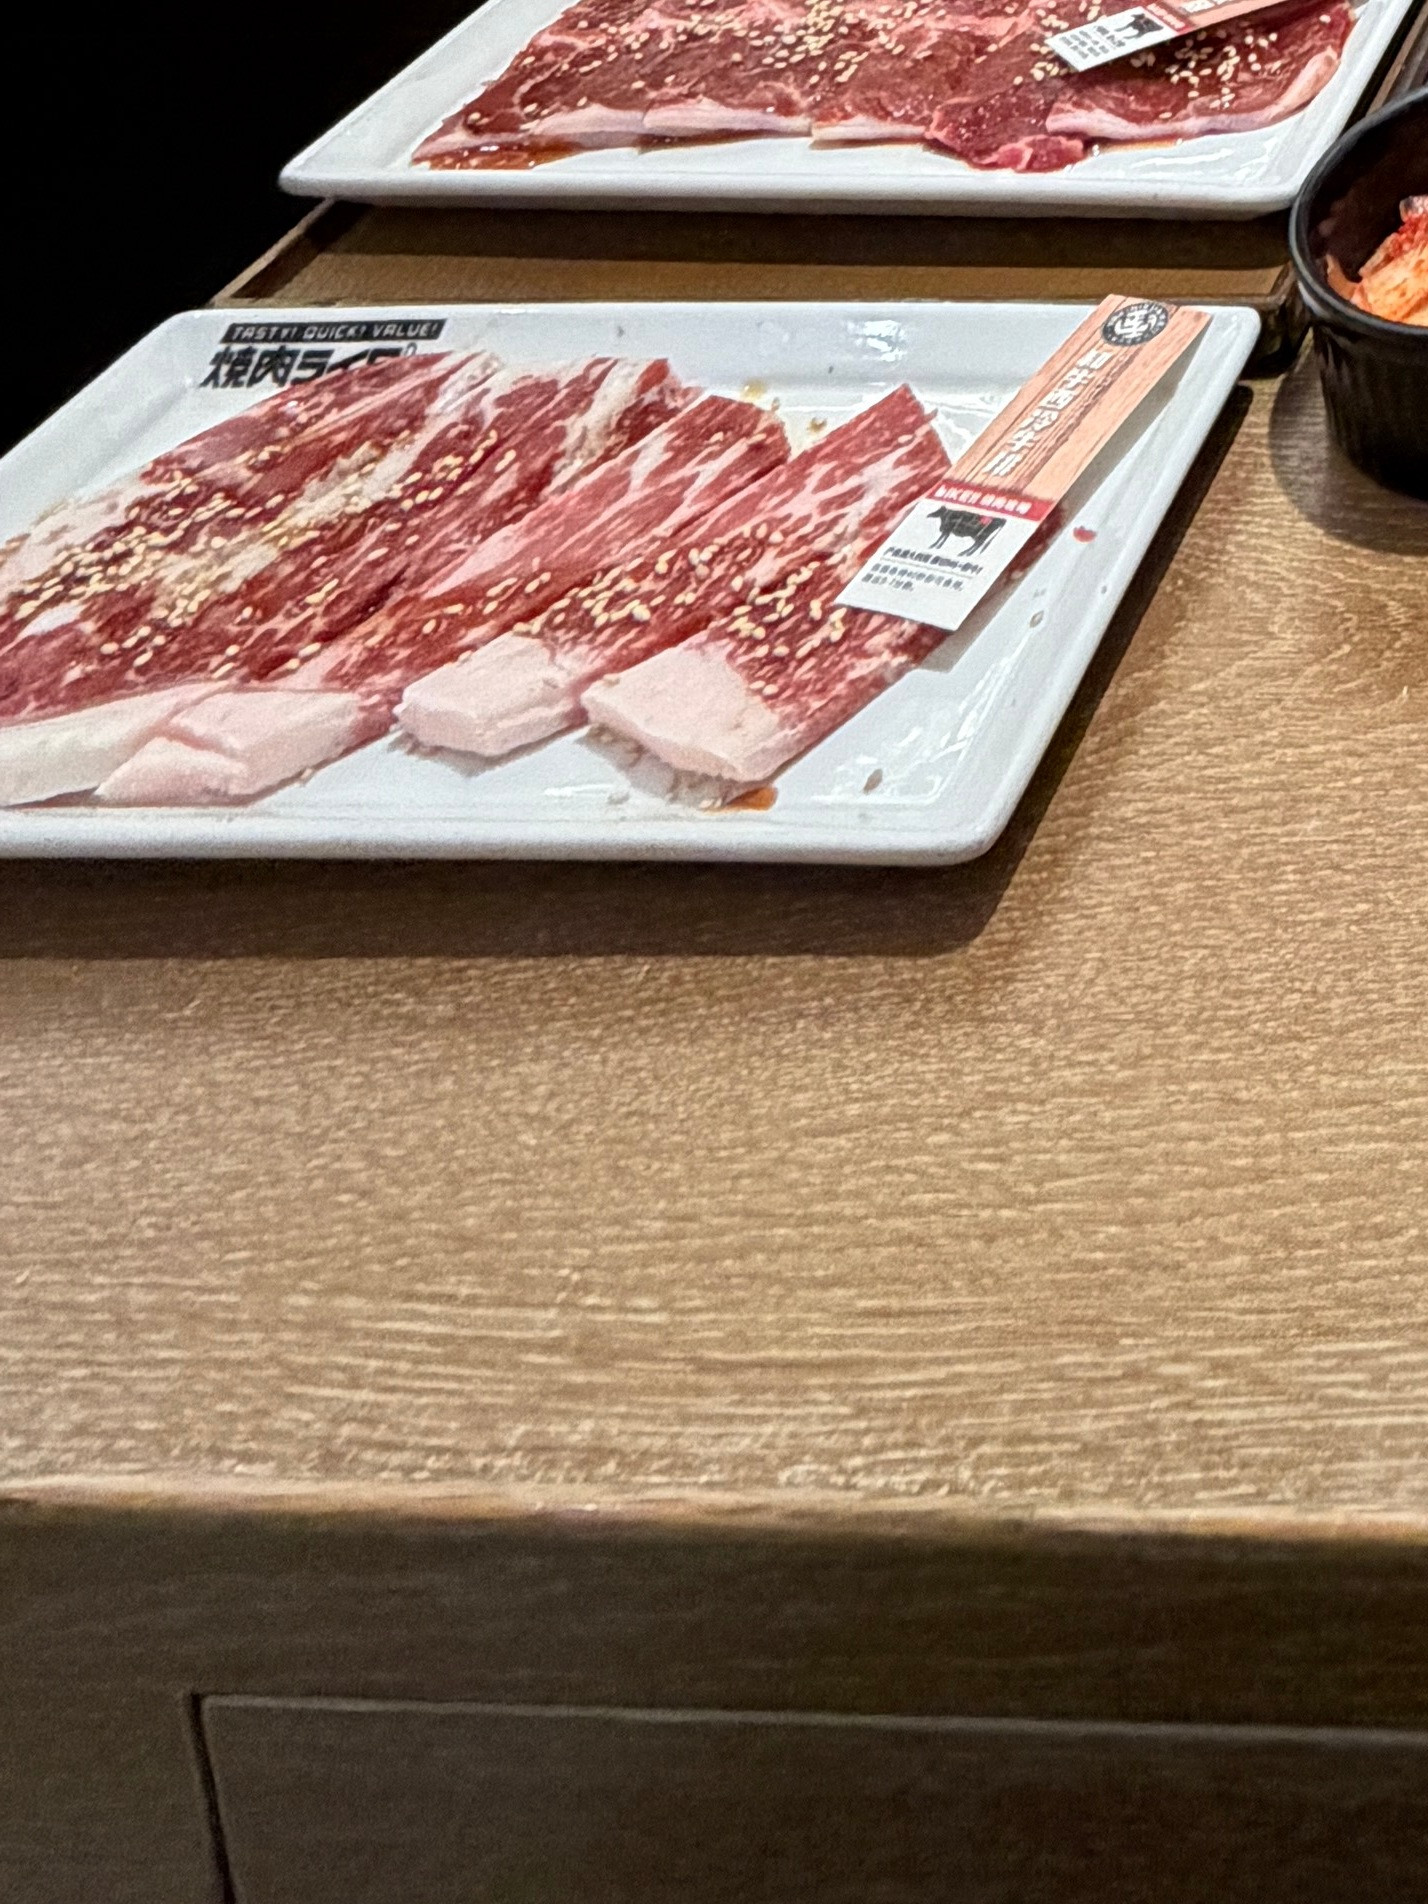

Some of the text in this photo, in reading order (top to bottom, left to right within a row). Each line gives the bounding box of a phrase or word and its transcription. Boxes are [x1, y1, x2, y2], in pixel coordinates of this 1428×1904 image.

[230, 321, 440, 342] TASTY! QUICK! VALUE!
[982, 347, 1115, 478] 和牛西冷牛排
